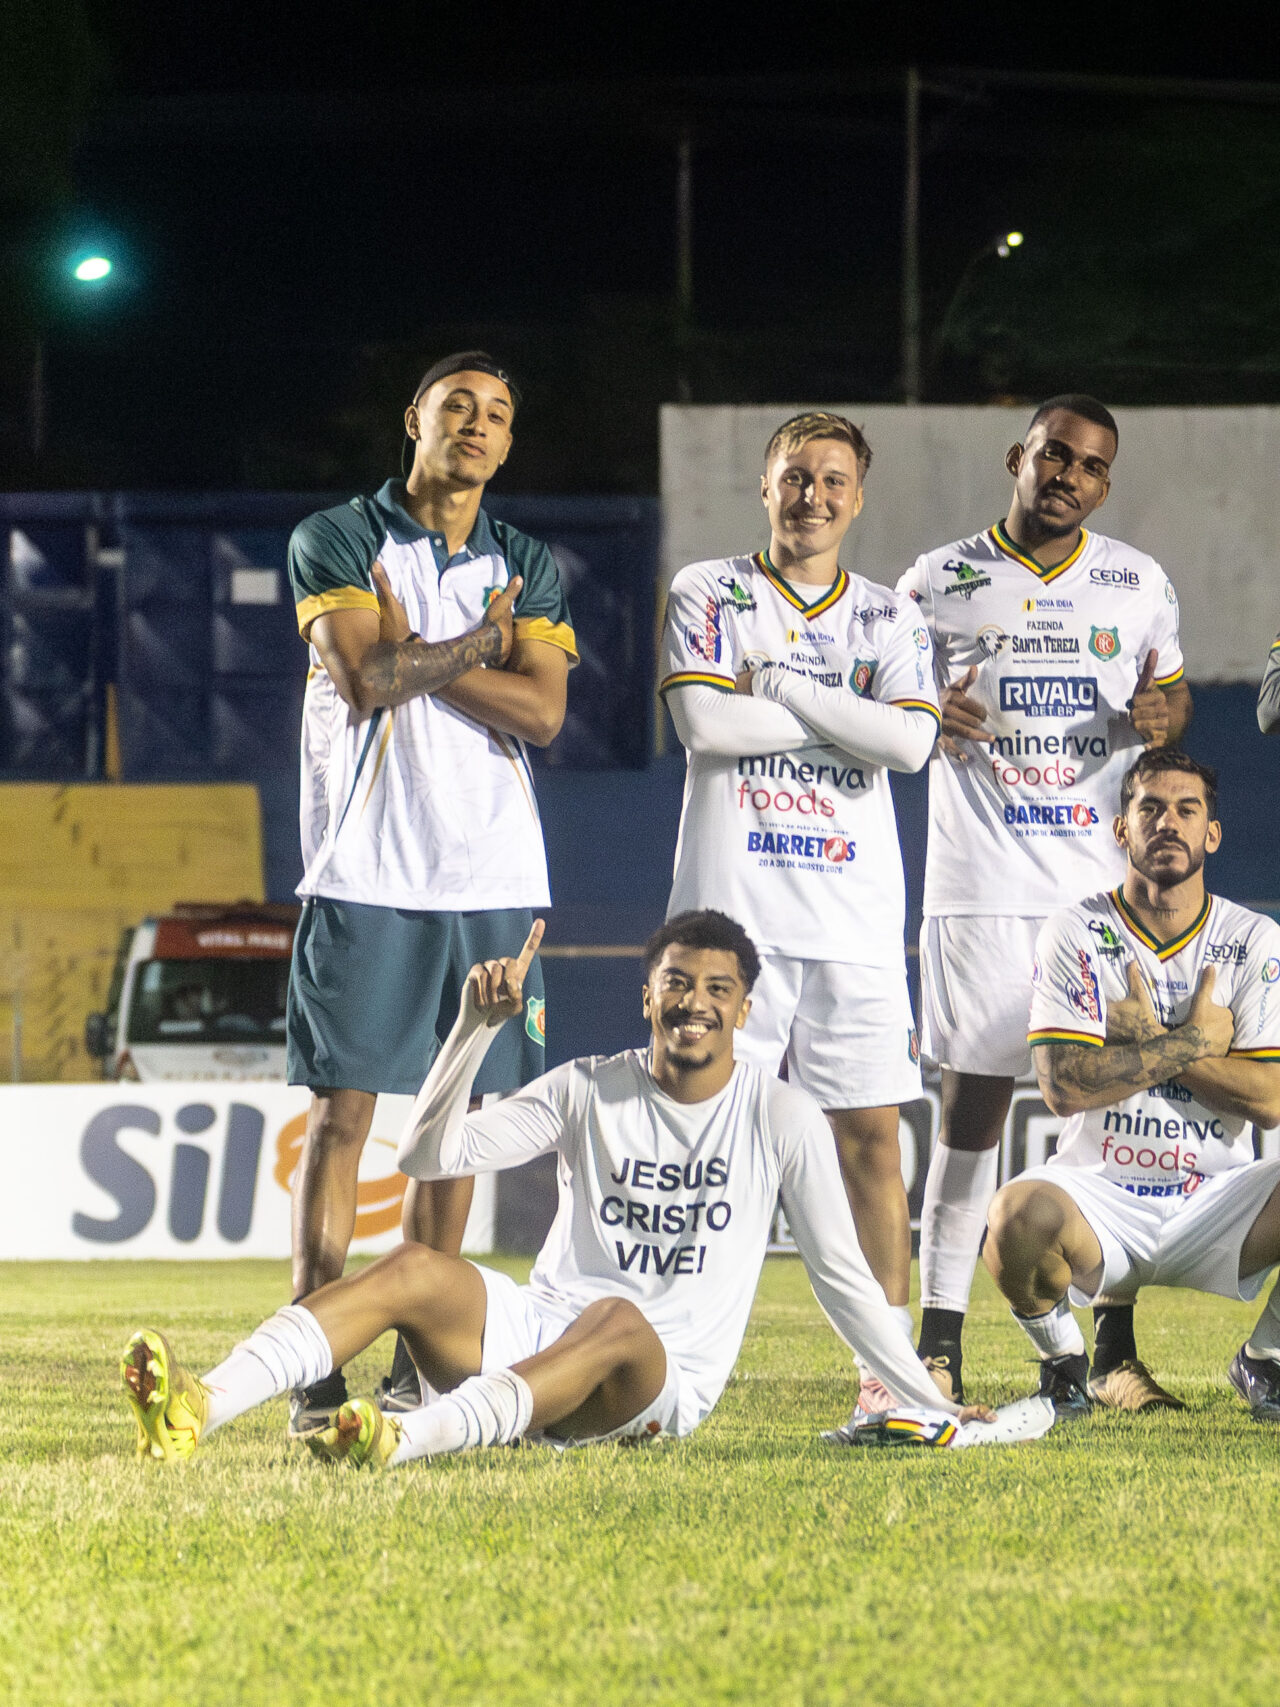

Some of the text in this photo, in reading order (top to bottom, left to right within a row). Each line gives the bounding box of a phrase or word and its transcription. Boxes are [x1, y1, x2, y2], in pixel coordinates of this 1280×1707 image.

[1036, 599, 1055, 608] NOVA
[1026, 621, 1064, 631] FAZENDA
[1012, 634, 1080, 654] SANTA TEREZA
[1005, 682, 1095, 706] RIVALO
[989, 729, 1108, 757] minerva
[738, 754, 867, 790] minerva
[992, 759, 1076, 786] foods
[737, 780, 836, 817] foods
[1004, 803, 1100, 828] BARRETOS
[747, 831, 856, 862] BARRETOS
[1101, 1135, 1198, 1172] foods
[610, 1157, 728, 1192] JESUS
[599, 1195, 732, 1235] CRISTO
[614, 1240, 707, 1276] VIVE!
